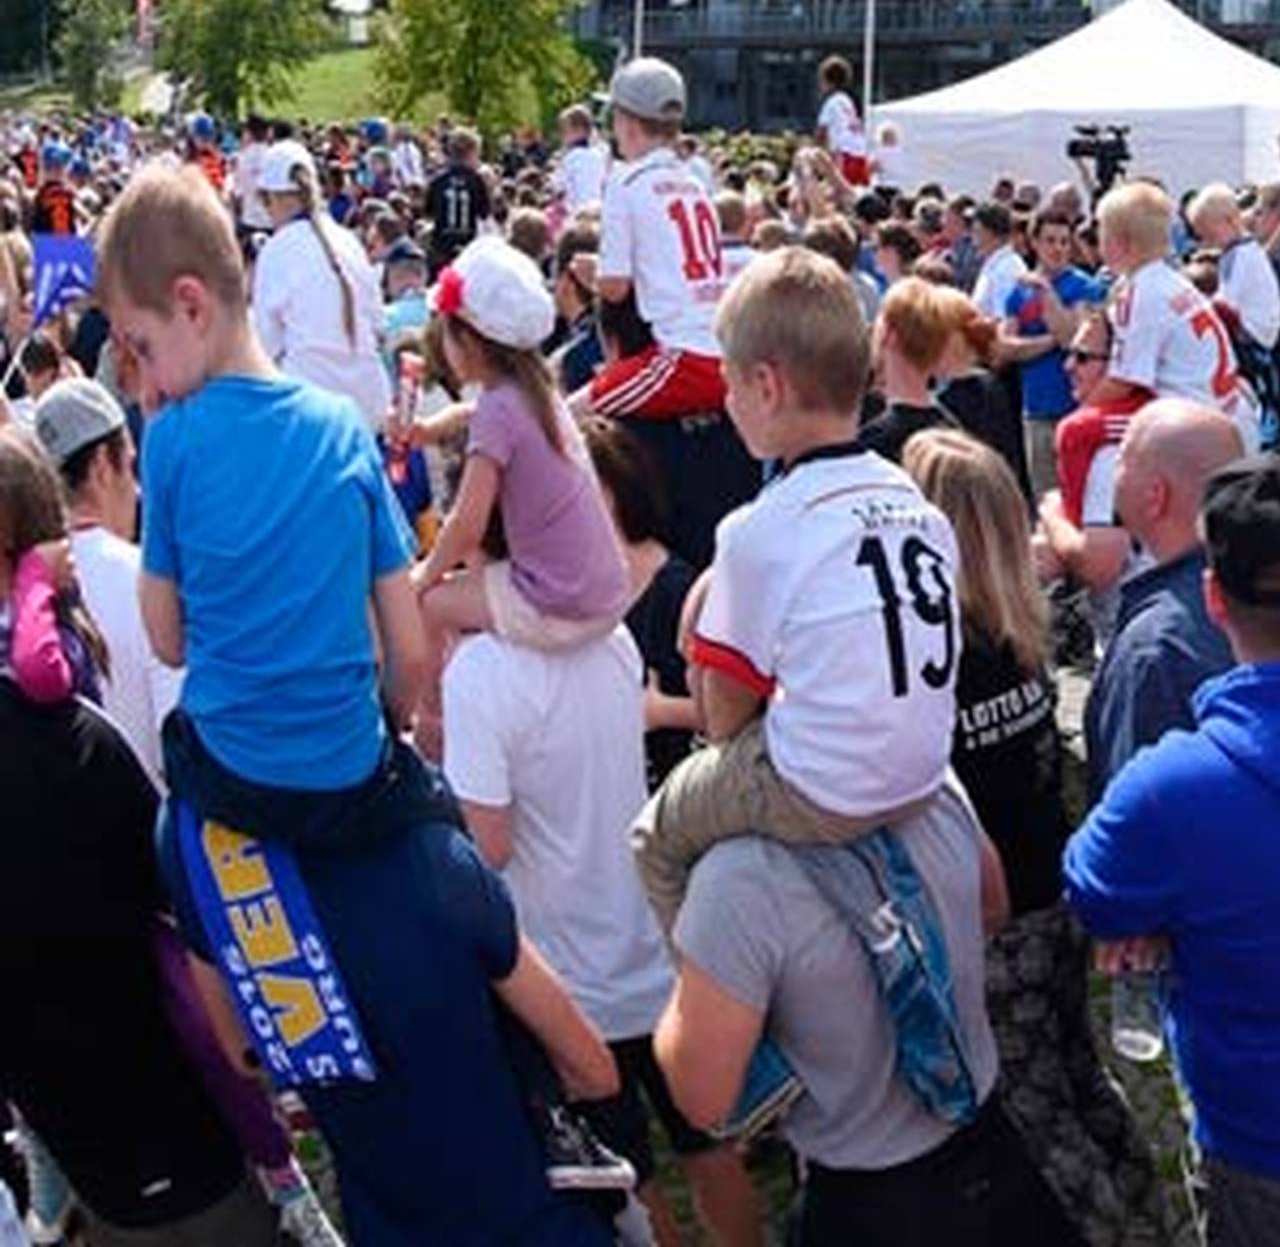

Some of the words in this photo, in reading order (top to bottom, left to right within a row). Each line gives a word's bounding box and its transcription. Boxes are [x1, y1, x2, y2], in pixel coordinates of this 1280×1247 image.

[445, 187, 470, 226] 11
[668, 200, 721, 280] 10
[855, 534, 955, 698] 19
[960, 688, 1023, 733] LOTTO
